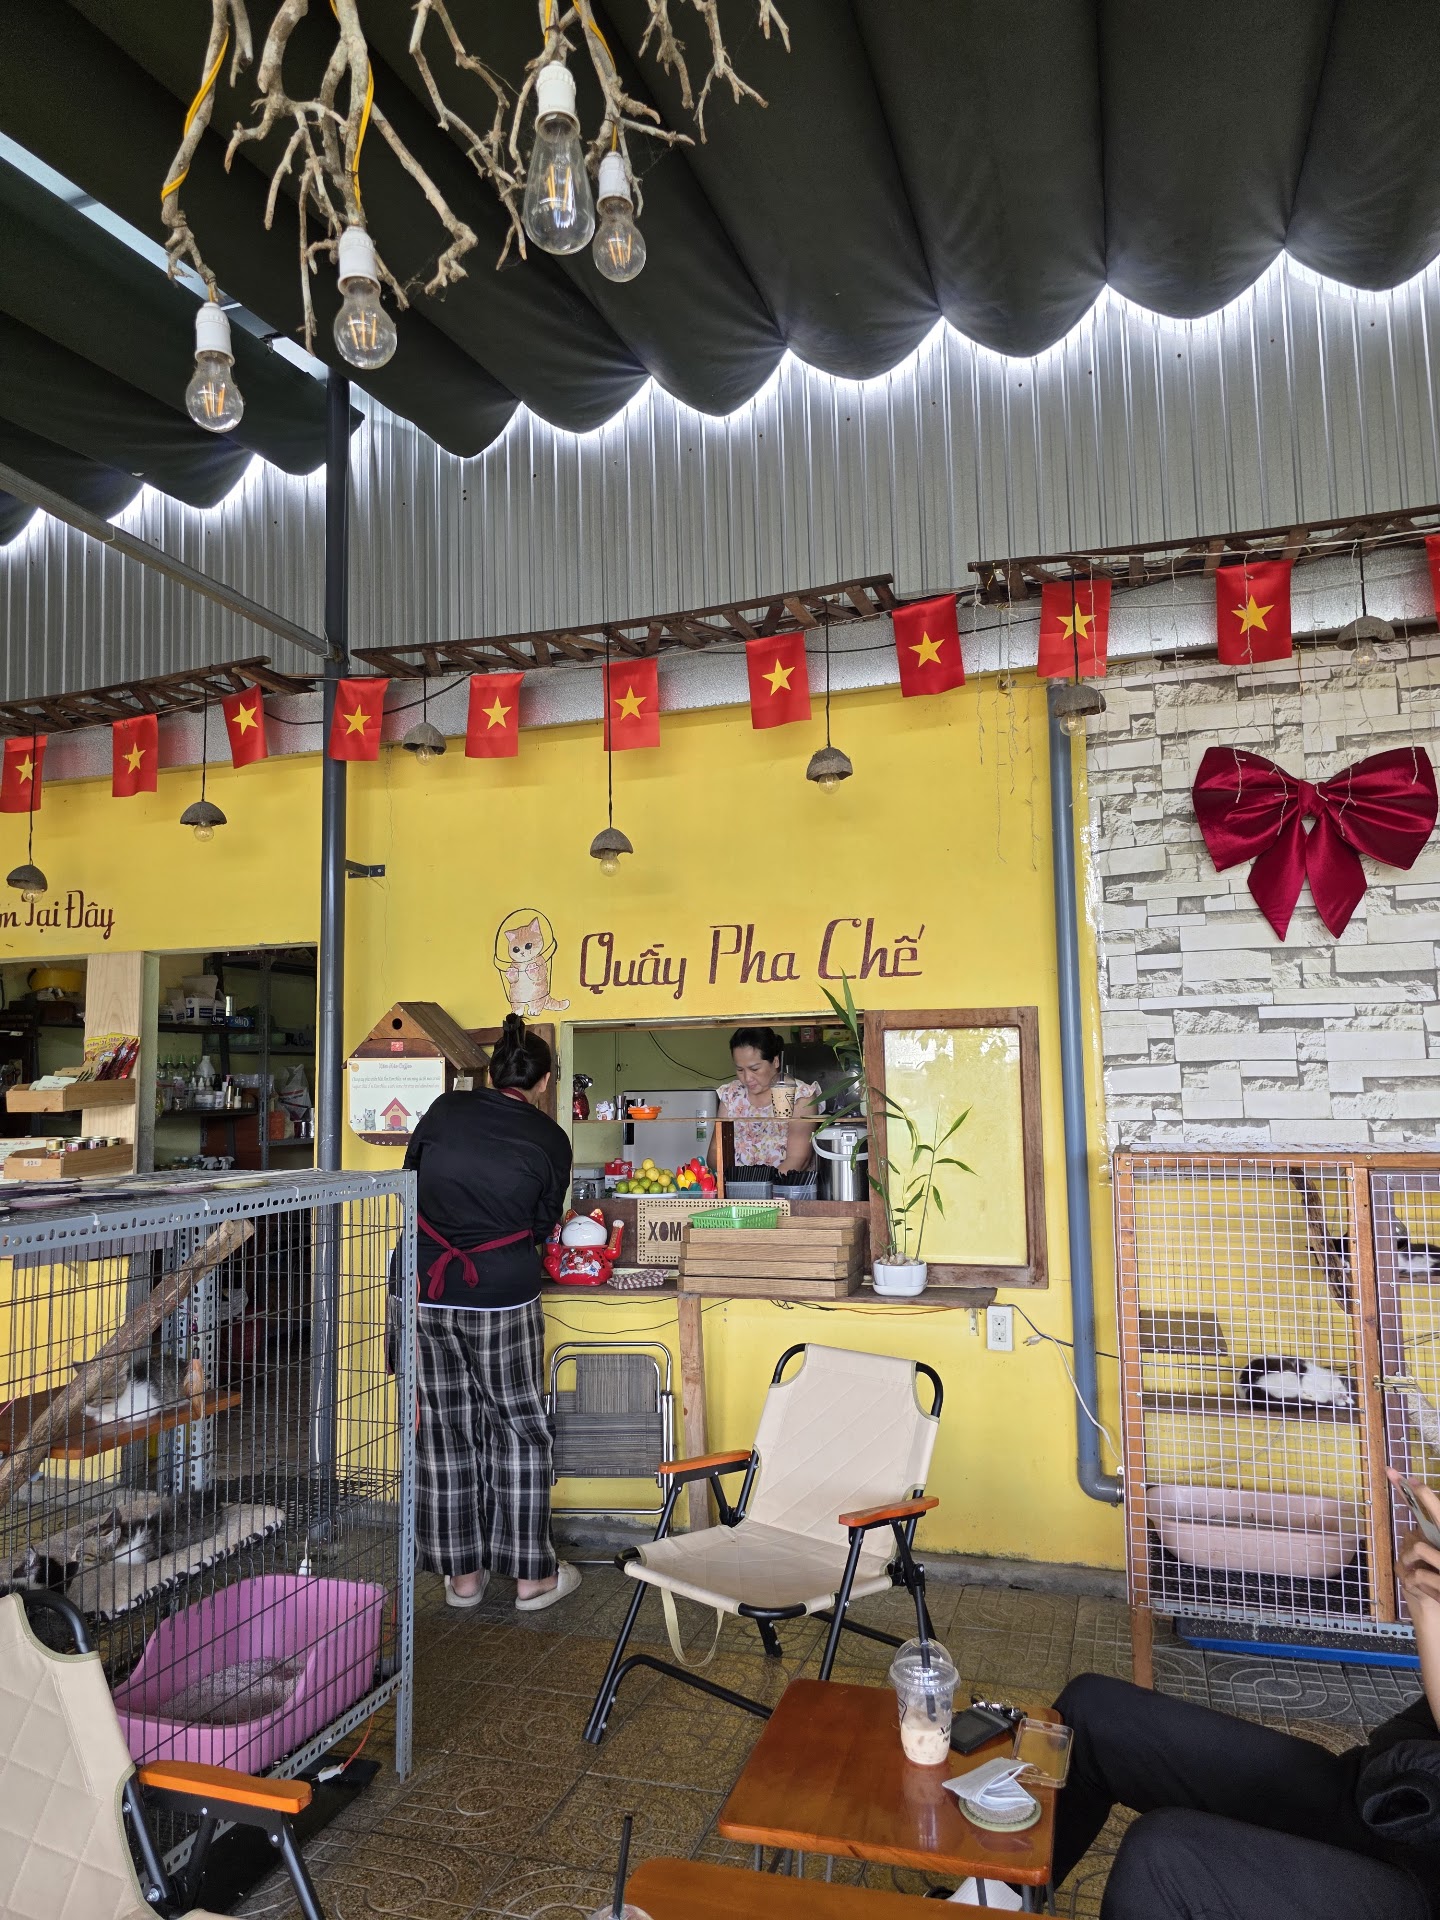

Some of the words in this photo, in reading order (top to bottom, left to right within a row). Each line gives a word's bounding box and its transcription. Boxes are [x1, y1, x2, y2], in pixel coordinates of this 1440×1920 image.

[64, 890, 115, 940] Đây
[709, 924, 800, 984] Pha
[818, 918, 925, 979] Chế
[648, 1220, 682, 1242] XOM
